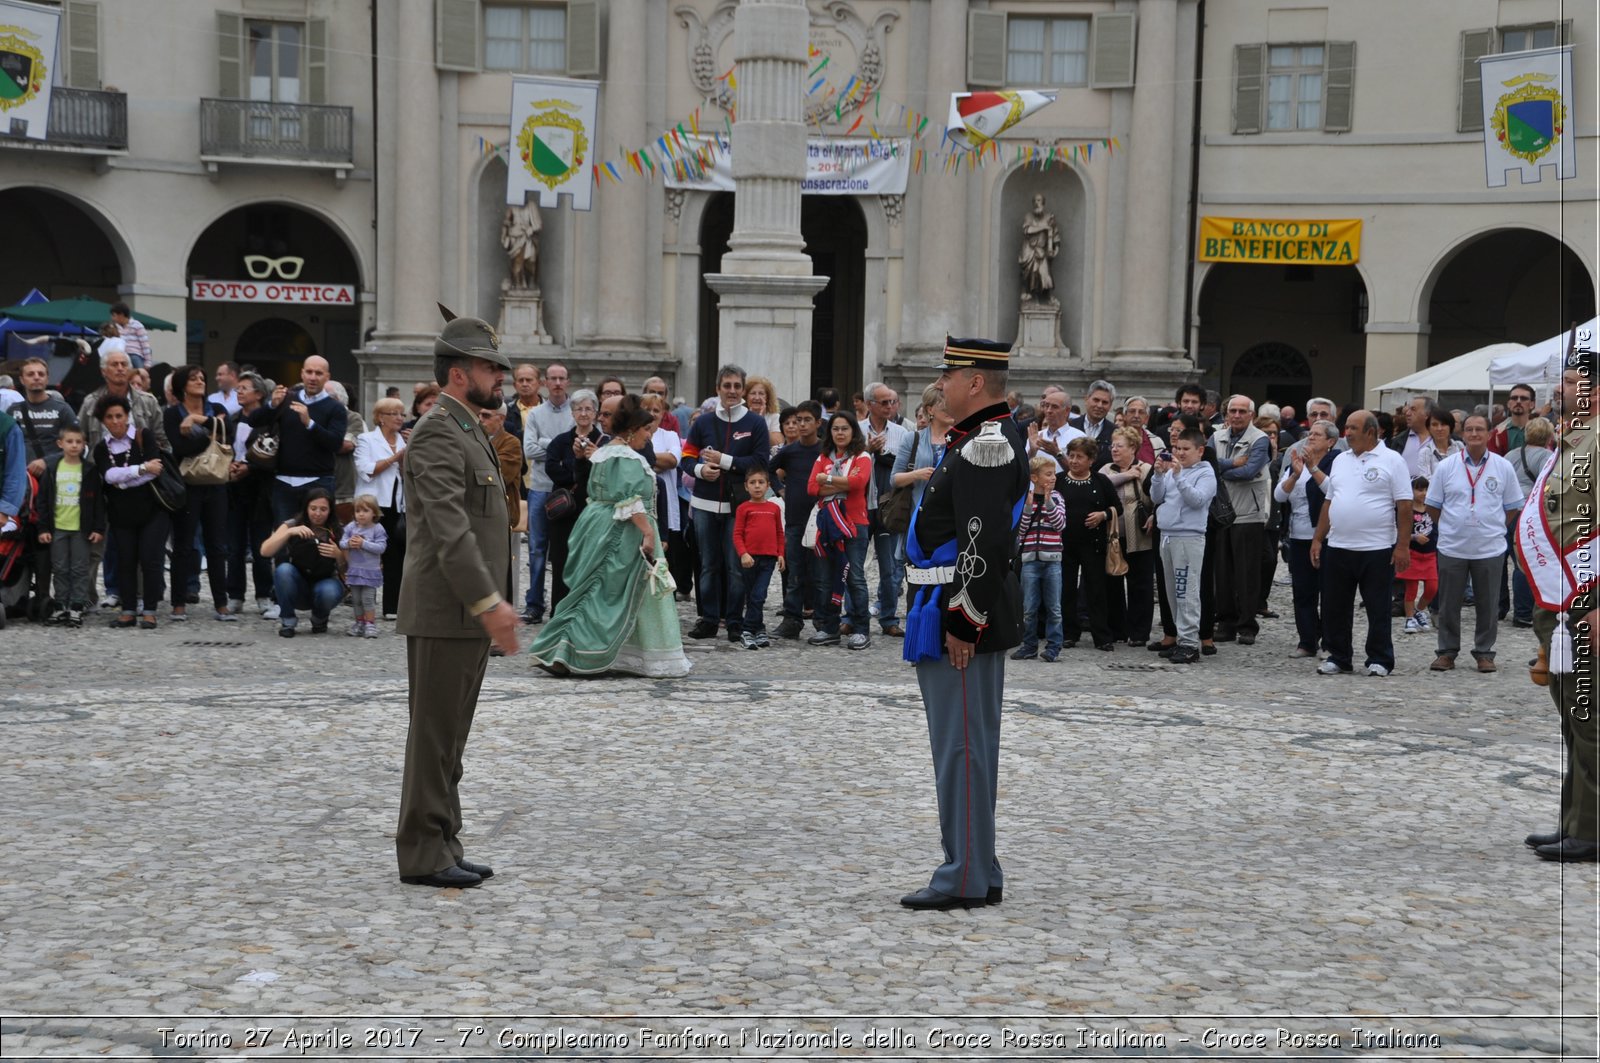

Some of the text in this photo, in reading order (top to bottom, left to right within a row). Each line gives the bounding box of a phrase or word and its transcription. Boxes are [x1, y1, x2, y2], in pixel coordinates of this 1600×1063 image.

[822, 144, 833, 158] di
[835, 143, 864, 158] Maria
[801, 177, 869, 190] onsacrazione
[1232, 222, 1329, 238] BANCO DI
[1205, 238, 1353, 261] BENEFICENZA
[195, 283, 352, 302] FOTO OTTICA
[1525, 517, 1547, 567] CARITAS
[1175, 565, 1189, 599] REBEL
